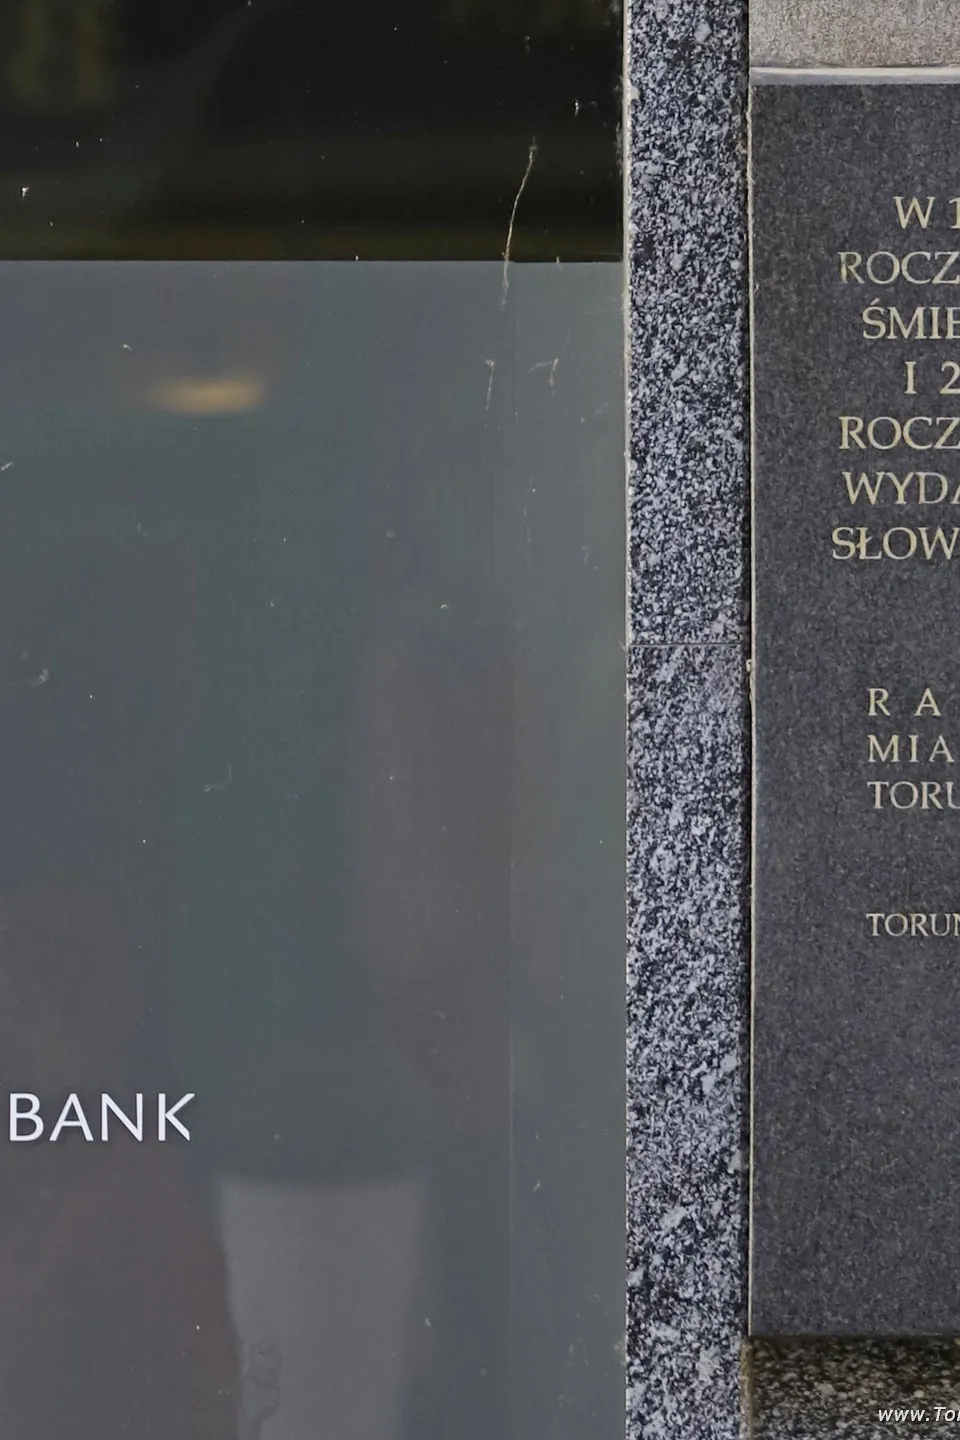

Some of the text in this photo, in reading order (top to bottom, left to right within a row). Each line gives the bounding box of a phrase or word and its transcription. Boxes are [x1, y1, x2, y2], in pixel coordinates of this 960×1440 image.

[894, 196, 935, 229] W
[905, 362, 916, 394] I
[9, 1092, 195, 1142] BANK
